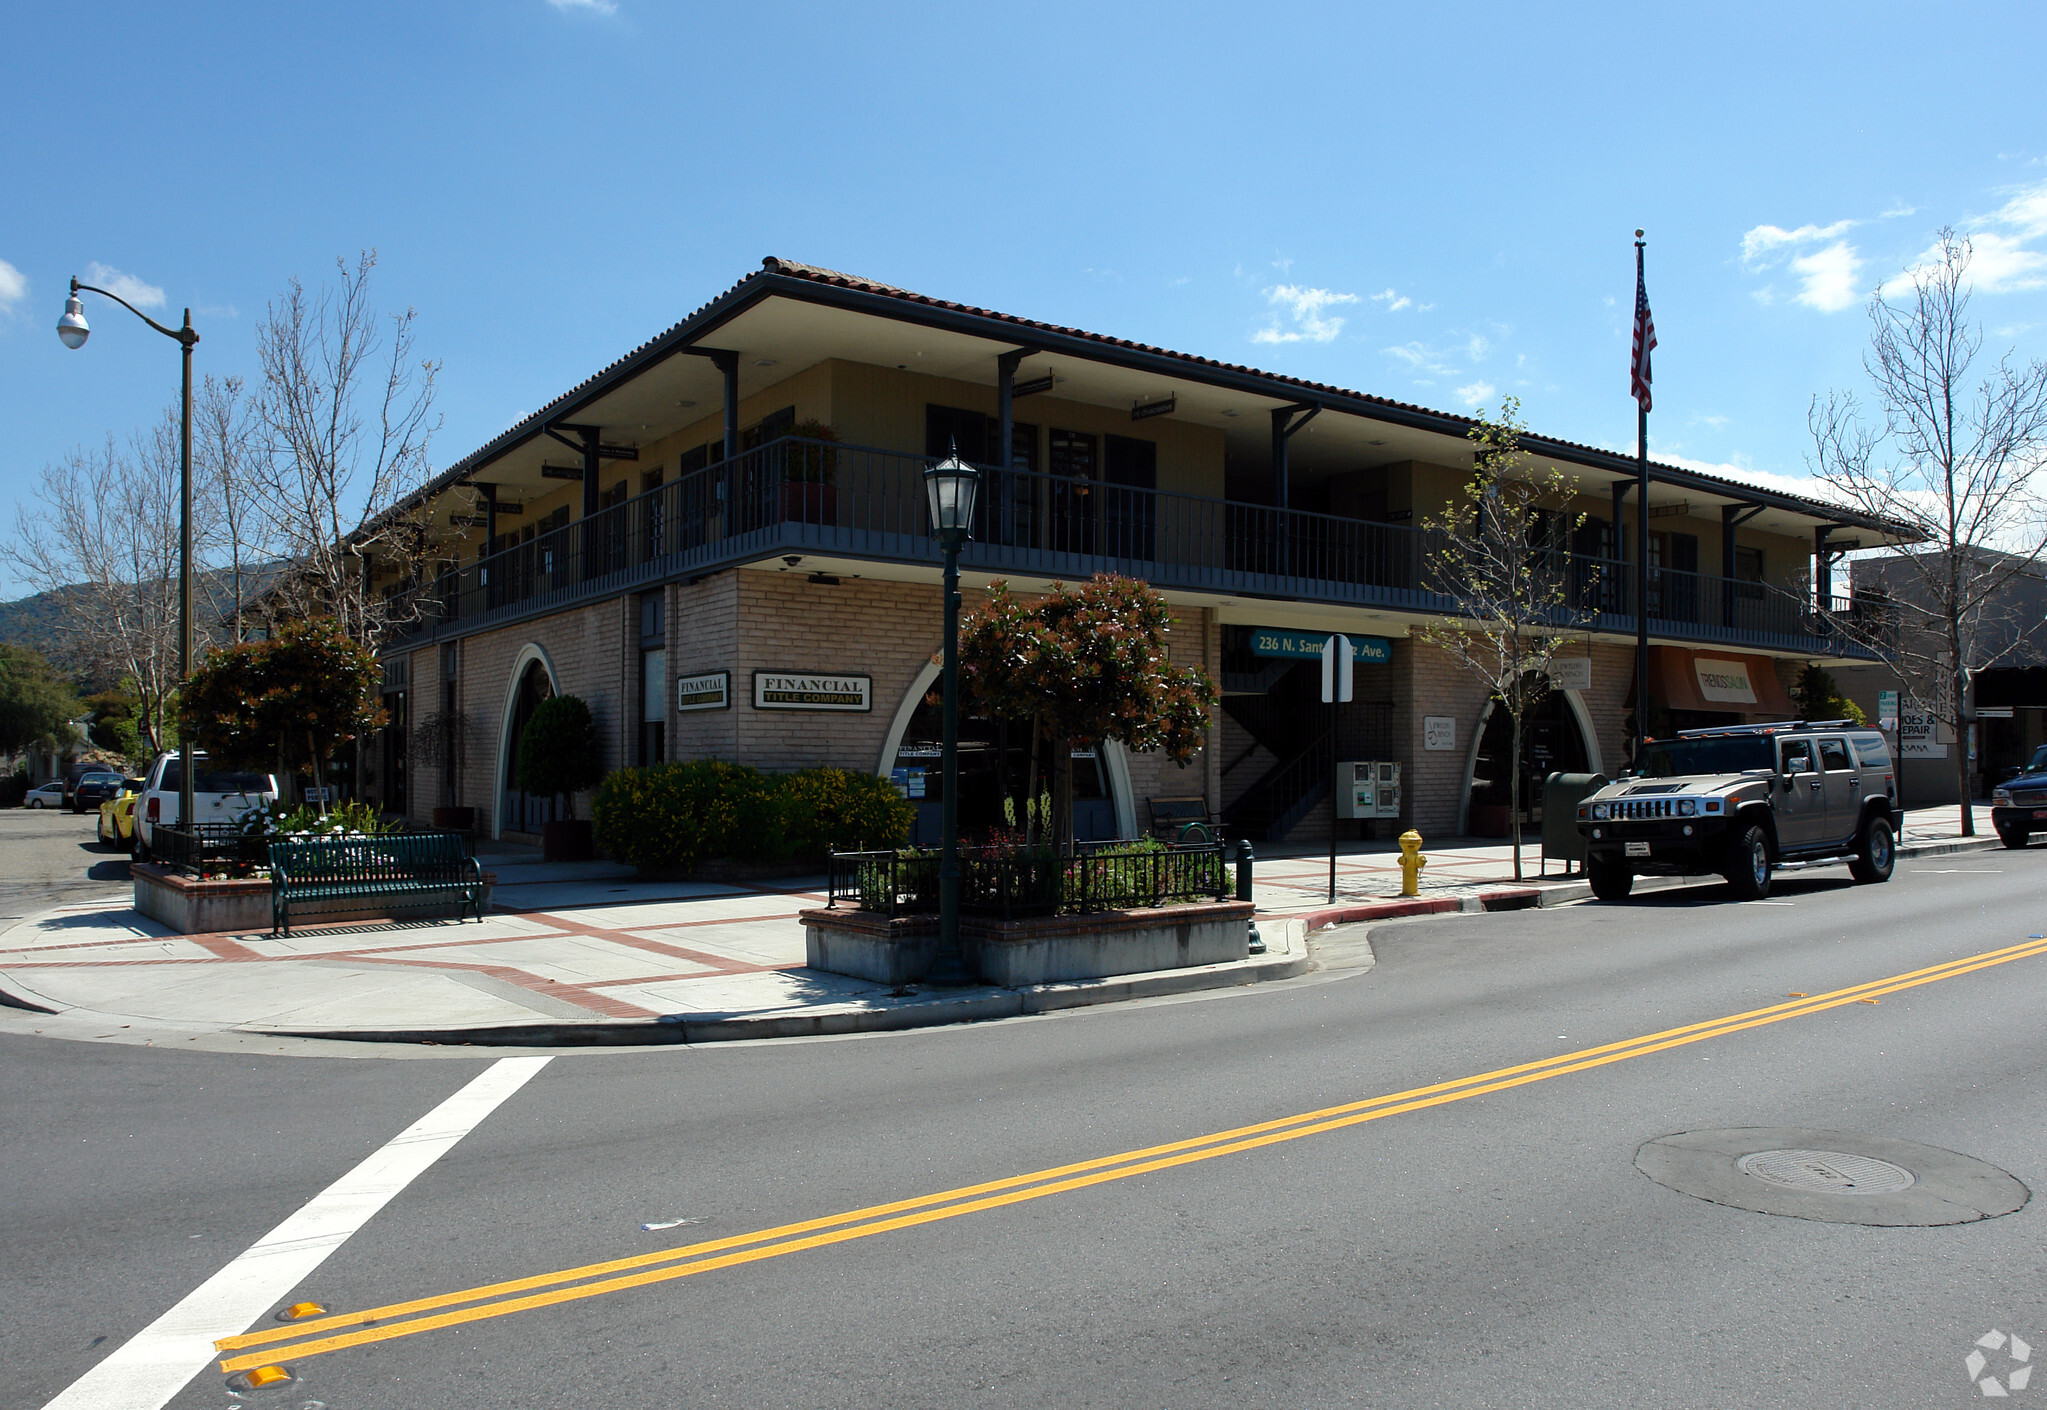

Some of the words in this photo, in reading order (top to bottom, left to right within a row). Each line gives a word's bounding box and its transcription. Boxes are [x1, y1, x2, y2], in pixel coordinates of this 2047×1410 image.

[1259, 636, 1279, 650] 236
[1282, 638, 1296, 652] N.
[1361, 644, 1385, 658] Ave.
[681, 679, 723, 693] FINANCIAL
[764, 678, 863, 693] FINANCIAL
[681, 694, 696, 704] TITLE
[697, 692, 723, 704] COMPANY
[764, 692, 801, 703] TITLE
[803, 693, 863, 704] COMPANY
[1927, 715, 1935, 725] &
[1901, 726, 1930, 734] EPAIR
